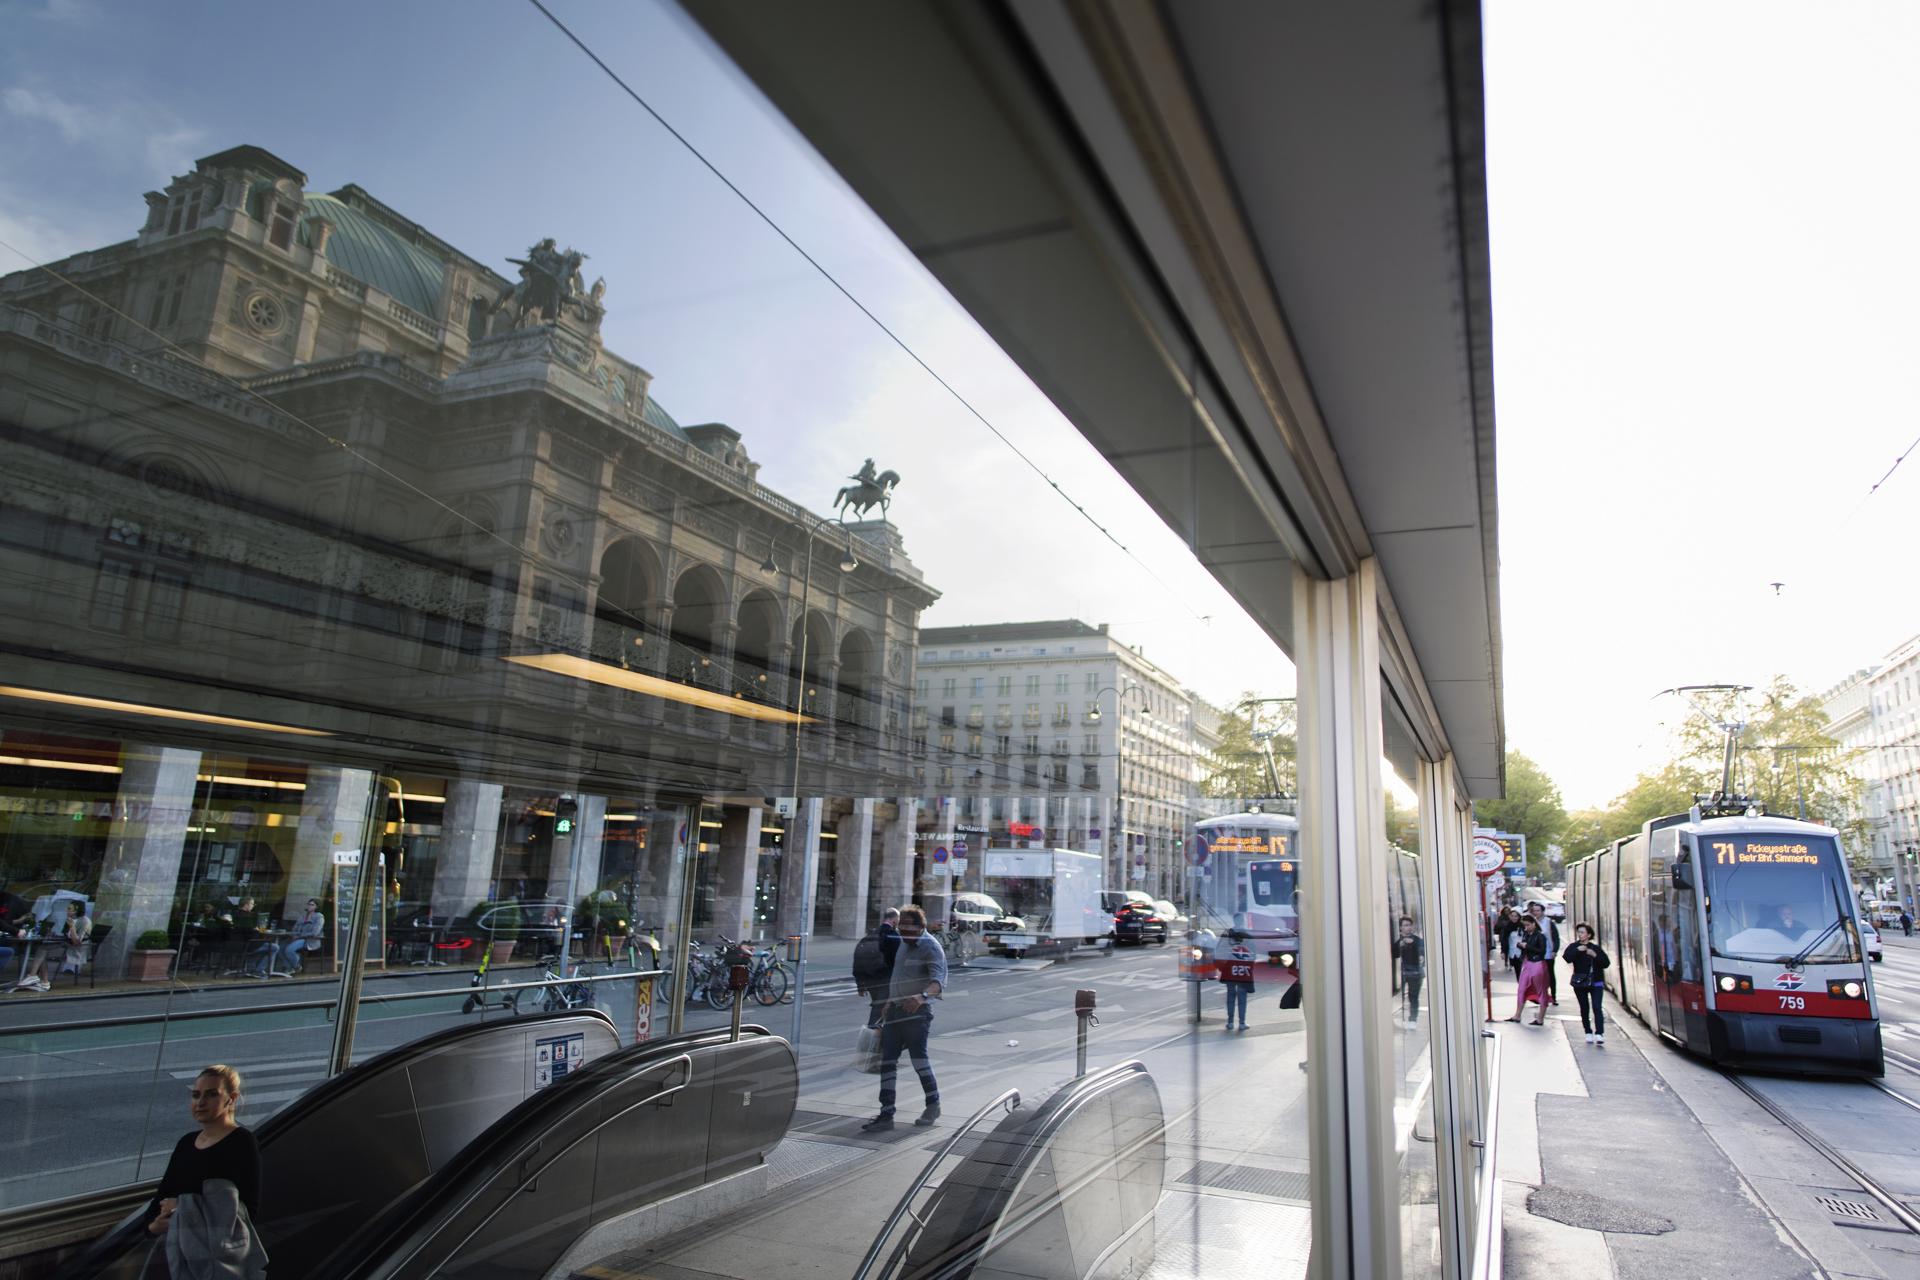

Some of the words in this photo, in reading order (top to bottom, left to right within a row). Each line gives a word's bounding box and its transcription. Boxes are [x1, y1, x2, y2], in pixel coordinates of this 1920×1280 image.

[1712, 843, 1735, 864] 71
[1747, 844, 1808, 854] Fickeysstraße
[1775, 854, 1818, 864] Simmering
[638, 980, 651, 1034] oe24
[1779, 996, 1805, 1009] 759
